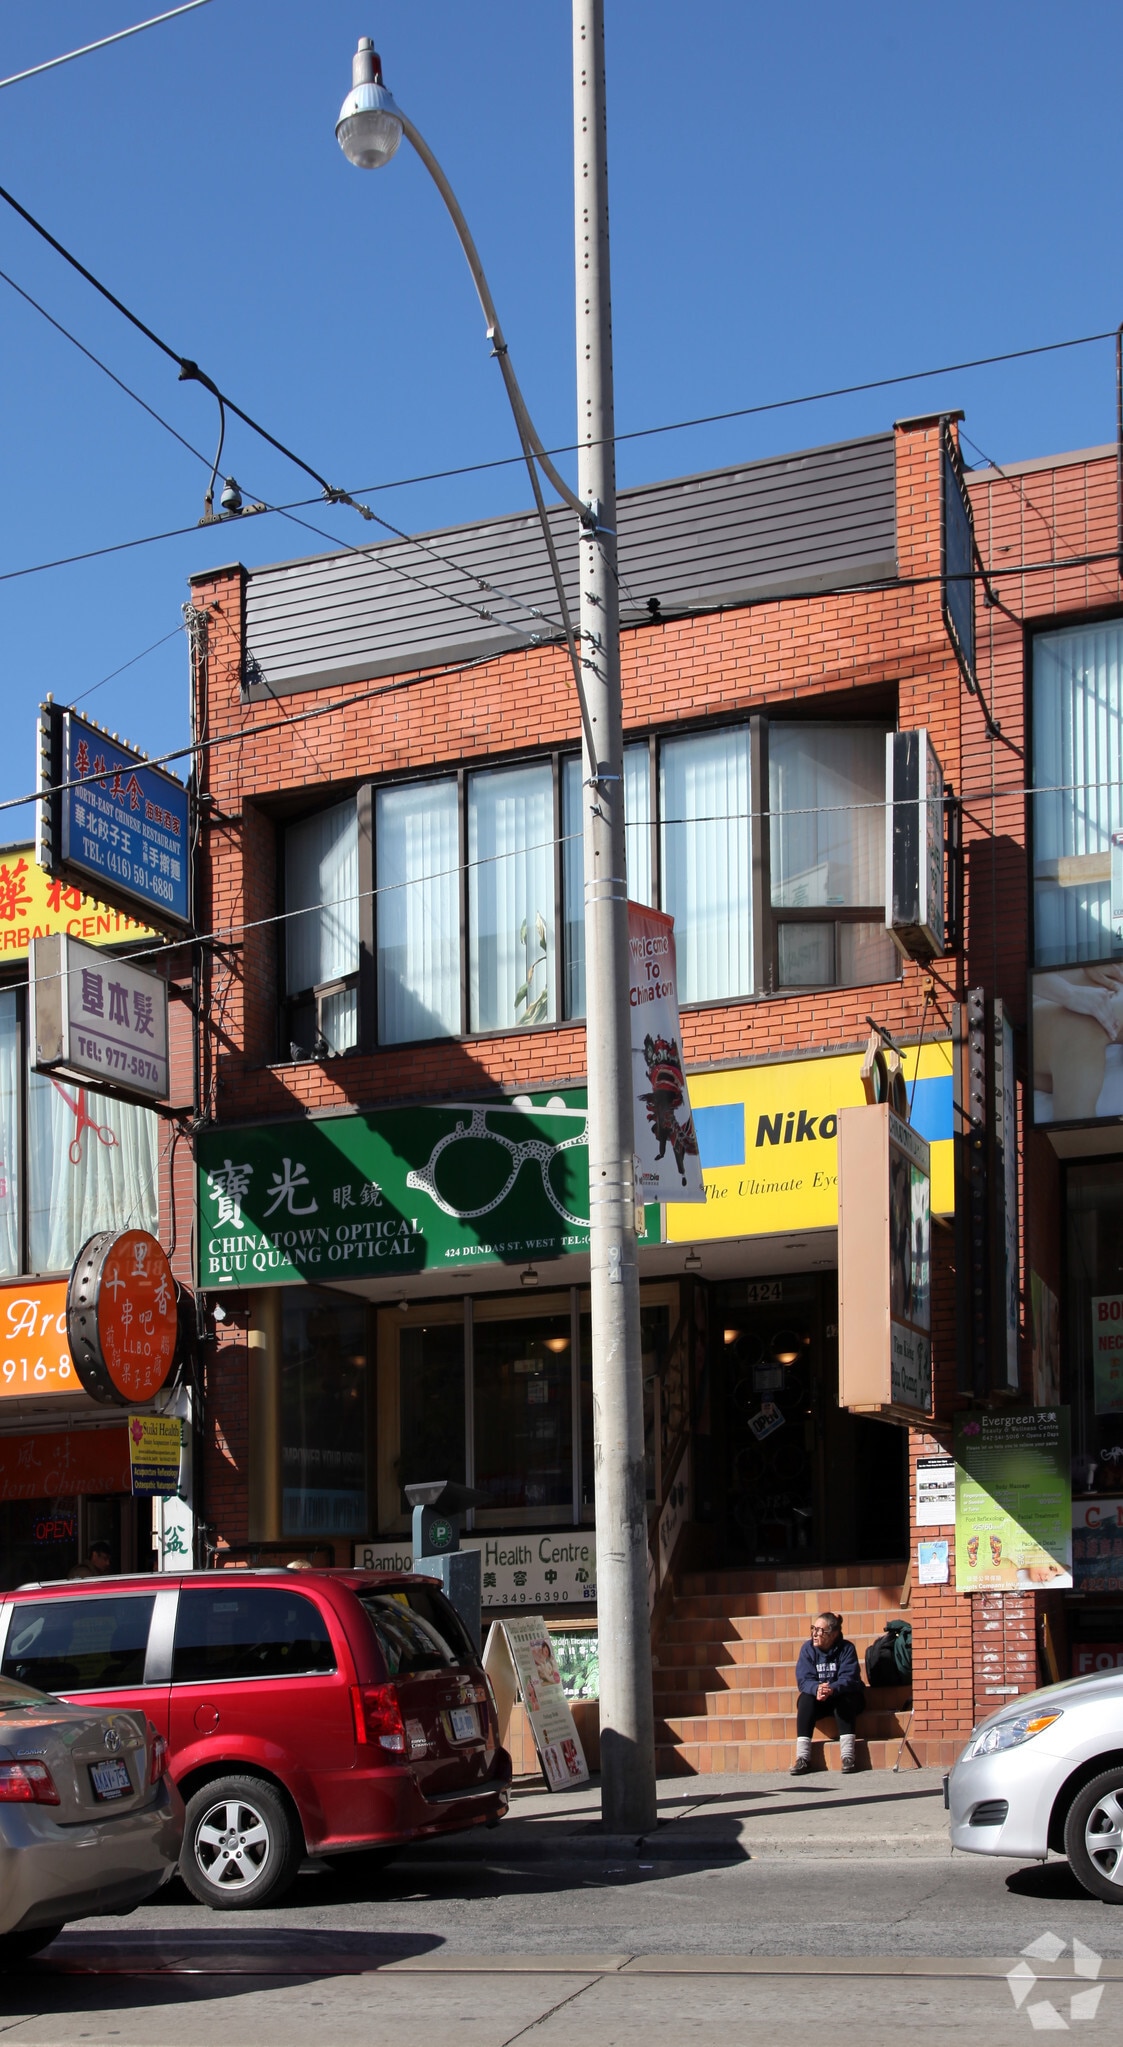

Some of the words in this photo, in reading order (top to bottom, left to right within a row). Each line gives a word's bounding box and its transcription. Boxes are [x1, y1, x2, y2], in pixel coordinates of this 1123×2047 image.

[75, 786, 115, 818] NORTH-EAST
[115, 809, 141, 834] CHINESE
[142, 824, 181, 856] RESTAURANT
[83, 836, 104, 866] TEL:
[107, 850, 132, 883] (416)
[134, 865, 174, 902] 591-6880
[630, 936, 669, 960] Welcome
[78, 1036, 101, 1063] TEL:
[105, 1046, 158, 1083] 977-5876
[332, 1181, 383, 1211] 眼鏡
[702, 1185, 728, 1200] The
[738, 1178, 803, 1197] Ultimate
[208, 1225, 330, 1255] CHINATOWN
[335, 1218, 424, 1242] OPTICAL
[444, 1248, 462, 1258] 424
[462, 1243, 505, 1257] DUNDAS
[507, 1240, 523, 1252] ST.
[525, 1237, 556, 1250] WEST
[209, 1253, 248, 1274] BUU
[252, 1245, 321, 1272] QUANG
[327, 1238, 415, 1262] OPTICAL
[748, 1282, 781, 1302] 424
[1098, 1301, 1123, 1321] BO
[2, 1354, 71, 1384] 916-8
[159, 1422, 180, 1437] Health
[982, 1415, 1035, 1428] Evergreen
[44, 1470, 114, 1497] Chinese
[36, 1519, 74, 1540] OPEN
[485, 1539, 532, 1567] Health
[539, 1537, 589, 1564] Centre
[483, 1567, 589, 1588] 美容中心
[979, 1582, 1005, 1590] Company
